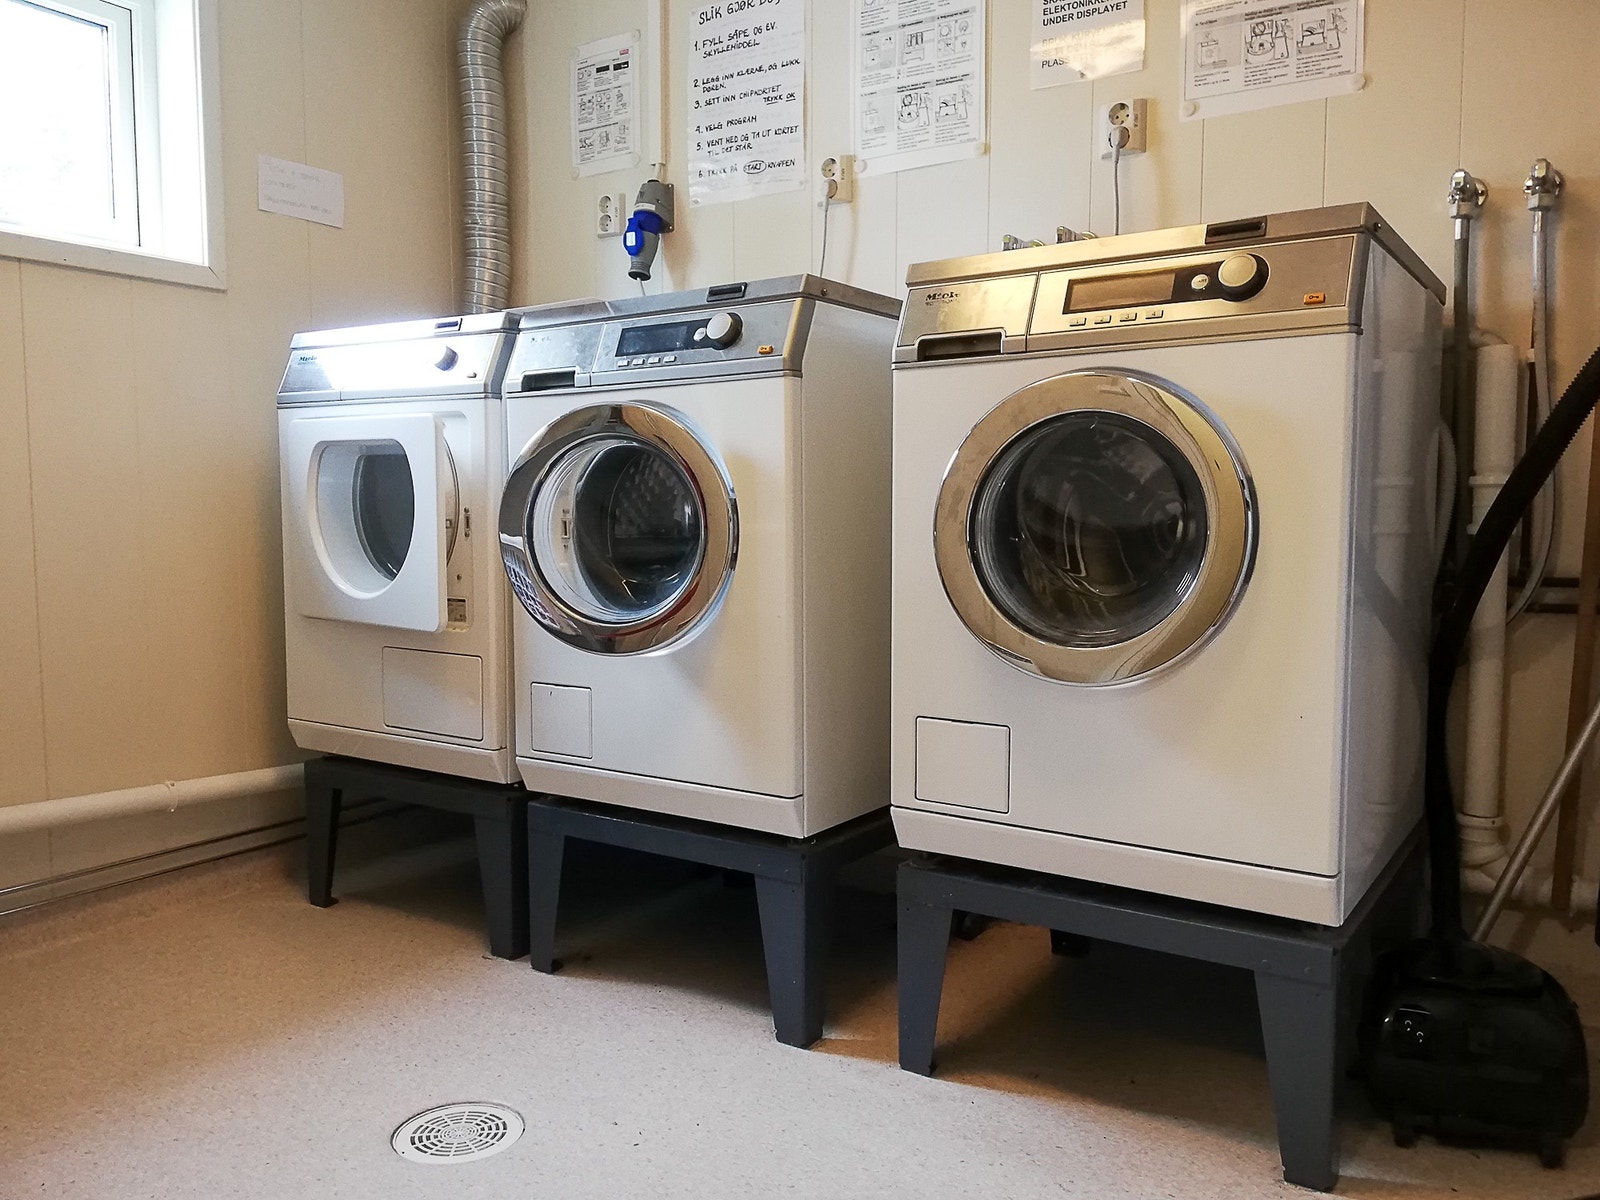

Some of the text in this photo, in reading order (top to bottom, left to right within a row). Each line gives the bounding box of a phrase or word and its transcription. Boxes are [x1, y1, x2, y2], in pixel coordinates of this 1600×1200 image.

[698, 0, 755, 25] SLIK GJØR
[1042, 1, 1128, 27] UNDER DISPLAYET
[694, 21, 778, 51] 1. FYLL SÅPE OG EV.
[702, 39, 760, 59] SKYLLEMIDDEL
[701, 75, 720, 85] LEGG
[721, 72, 735, 81] INN
[767, 62, 778, 70] OG
[780, 58, 801, 68] LUKK
[694, 84, 782, 110] 3. SETT INN CHIPKORTET
[763, 93, 784, 103] TRYKK
[705, 121, 723, 133] VELG
[726, 115, 757, 127] PROGRAM
[696, 141, 704, 151] 5.
[706, 137, 724, 148] VENT
[740, 133, 749, 142] OG
[751, 131, 760, 139] TA
[761, 128, 772, 138] UT
[774, 125, 799, 136] KORTET
[735, 142, 753, 152] STÅR
[744, 162, 763, 172] START
